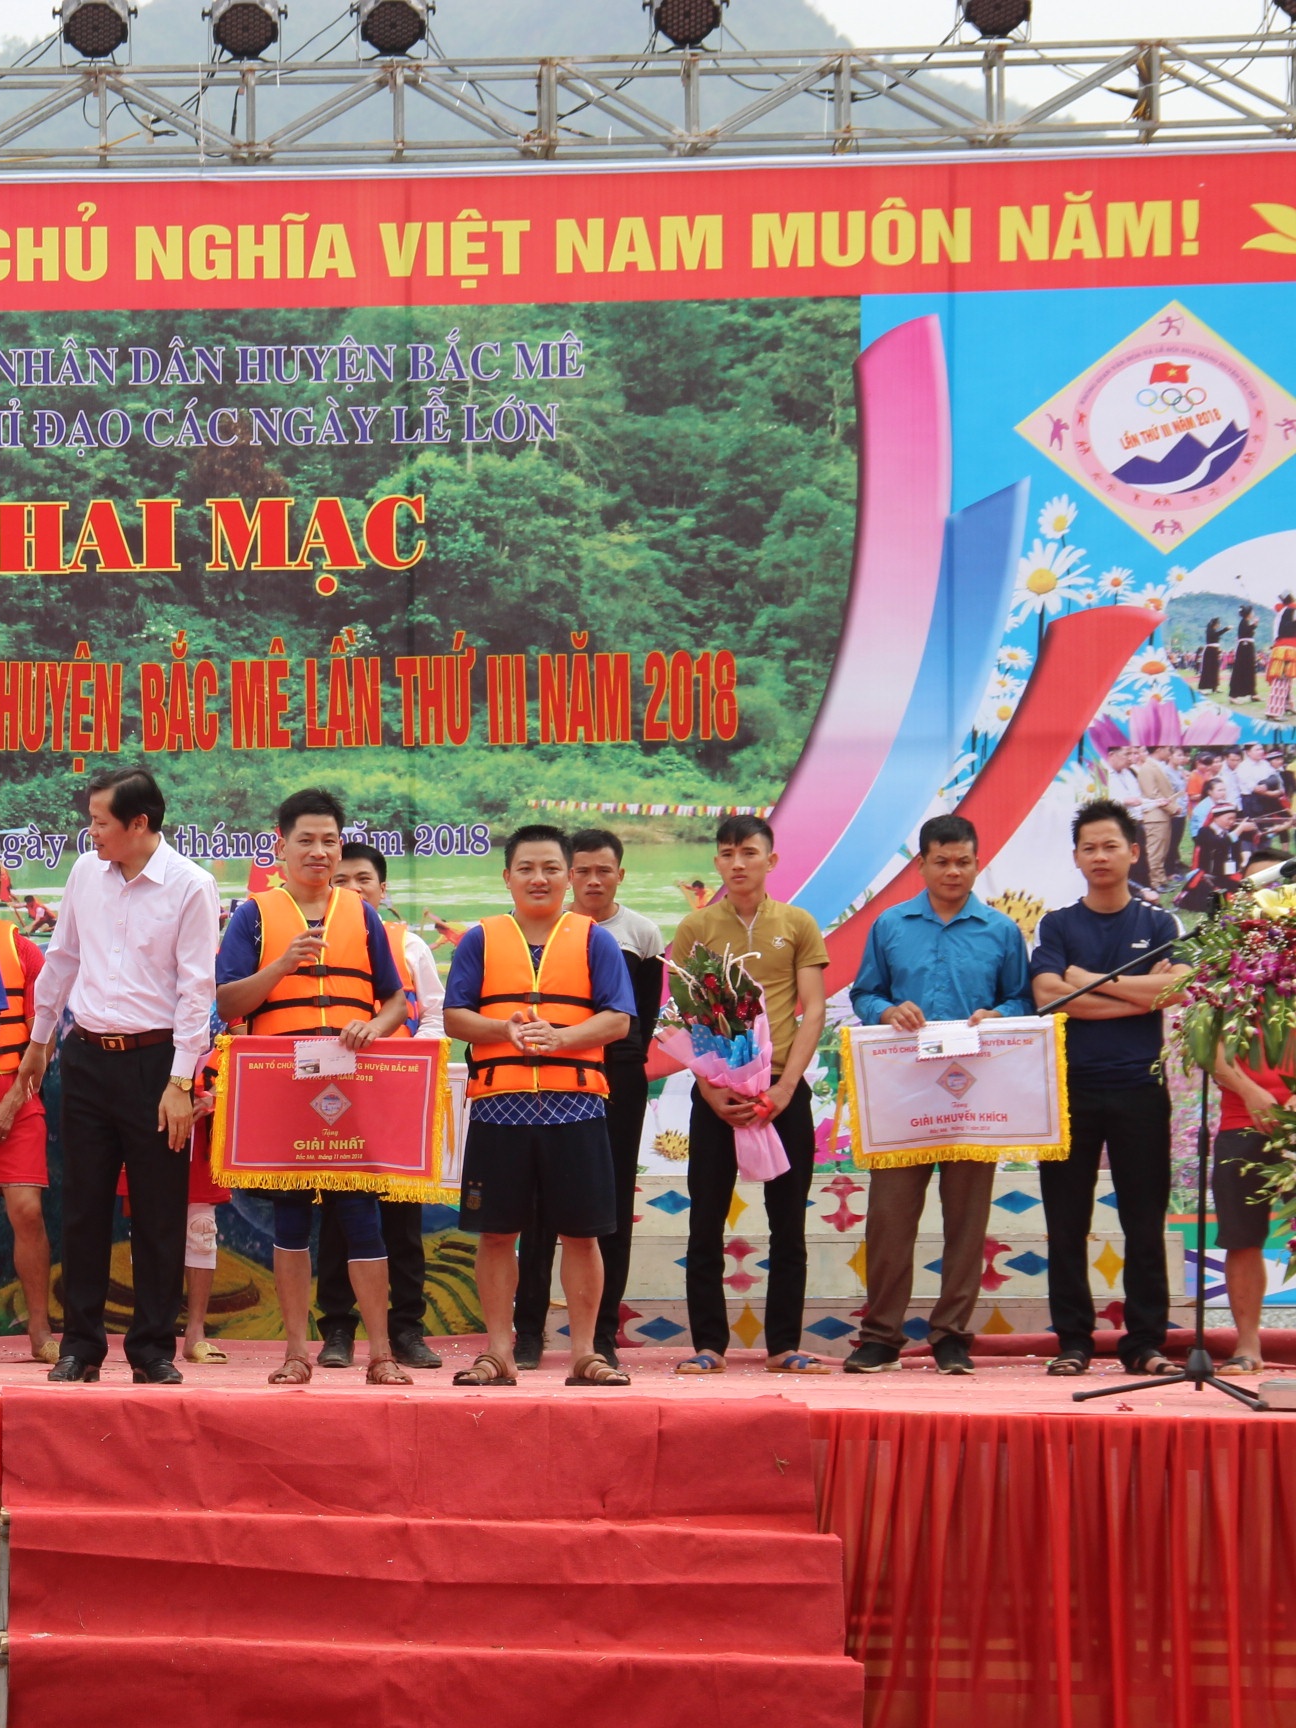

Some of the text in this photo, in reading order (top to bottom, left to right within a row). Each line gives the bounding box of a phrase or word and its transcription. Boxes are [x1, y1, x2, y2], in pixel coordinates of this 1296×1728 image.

[134, 212, 355, 281] NGHĨA
[379, 208, 531, 288] VIỆT
[555, 214, 724, 274] NAM
[750, 197, 972, 268] MUÔN
[998, 190, 1200, 262] NĂM!
[128, 335, 225, 386] DÂN
[238, 336, 400, 389] HUYỆN
[409, 327, 503, 383] BẮC
[512, 330, 587, 380] MÊ
[33, 408, 131, 457] ĐẠO
[142, 395, 239, 447] CÁC
[249, 394, 379, 447] NGÀY
[390, 381, 453, 444] LỄ
[460, 396, 560, 444] LỚN
[1172, 415, 1197, 434] NĂM
[1195, 408, 1222, 427] 2018
[205, 492, 428, 598] MẠC
[140, 630, 219, 752] BẮC
[230, 636, 292, 750] MÊ
[304, 628, 383, 749] LẦN
[395, 630, 477, 747] THỨ
[487, 653, 529, 745] III
[538, 631, 632, 745] NĂM
[643, 648, 740, 742] 2018
[174, 821, 278, 868] tháng
[413, 823, 491, 858] 2018
[248, 1062, 264, 1070] BAN
[265, 1060, 276, 1070] TỔ
[364, 1063, 390, 1072] HUYỆN
[391, 1061, 407, 1072] BẮC
[408, 1064, 420, 1073] MÊ
[355, 1074, 374, 1082] 2018
[910, 1109, 1008, 1127] GIẢI KHUYẾN KHÍCH
[293, 1135, 366, 1150] GIẢI NHẤT
